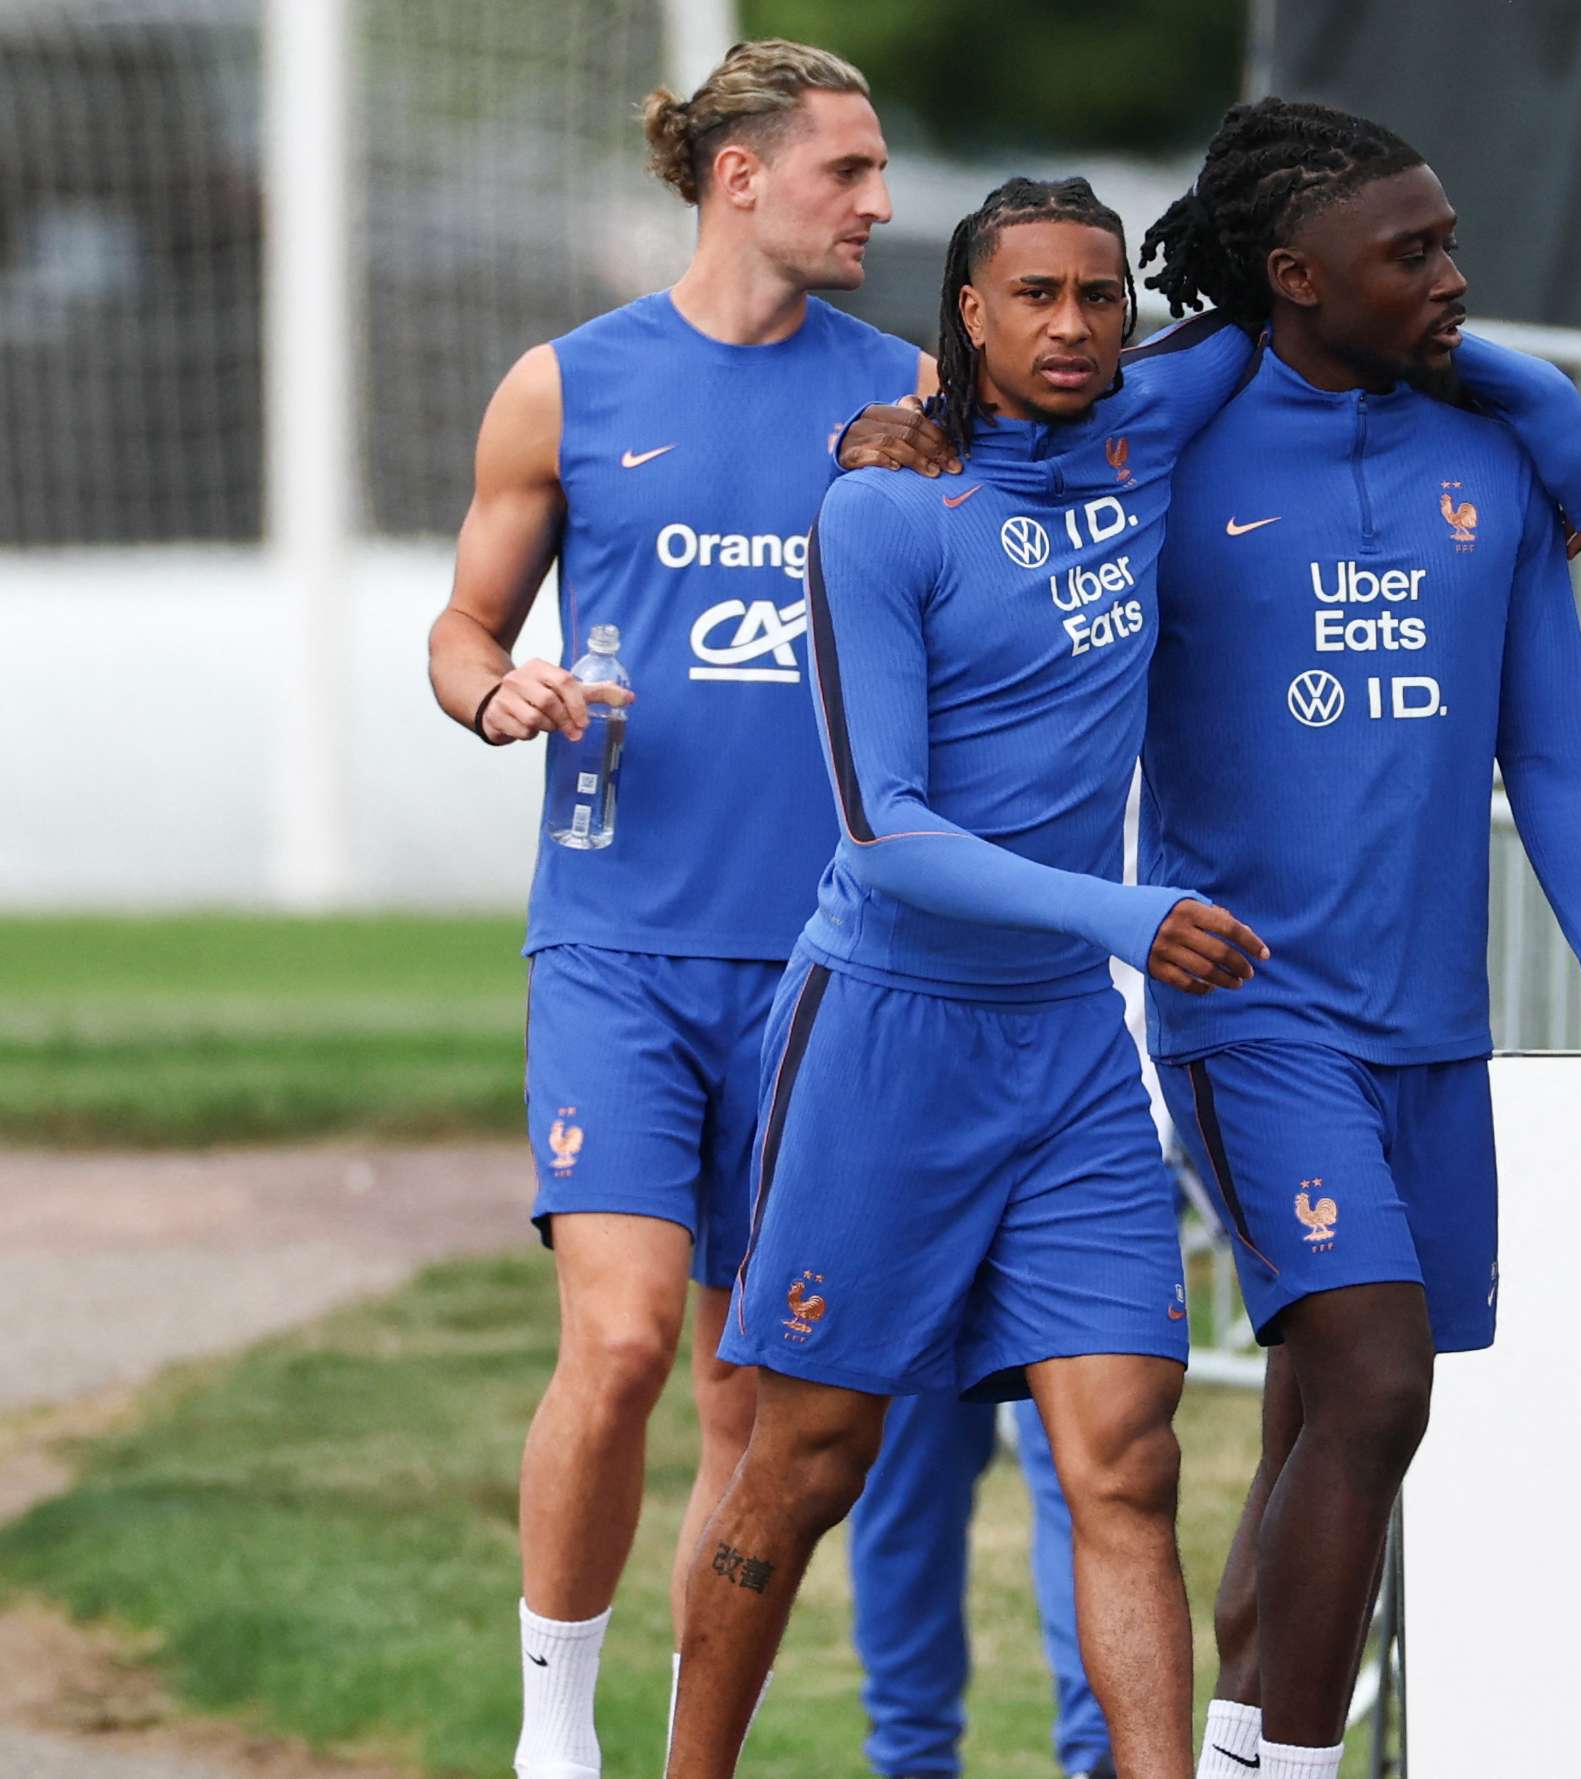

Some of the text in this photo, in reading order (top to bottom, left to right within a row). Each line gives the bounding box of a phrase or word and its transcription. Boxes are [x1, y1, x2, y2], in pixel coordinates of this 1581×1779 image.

[1065, 496, 1139, 549] ID.
[656, 523, 809, 579] Orang
[1050, 556, 1134, 611] Uber
[1310, 560, 1427, 603] Uber
[1062, 600, 1144, 657] Eats
[1315, 610, 1427, 652] Eats
[1287, 669, 1448, 727] VW ID.
